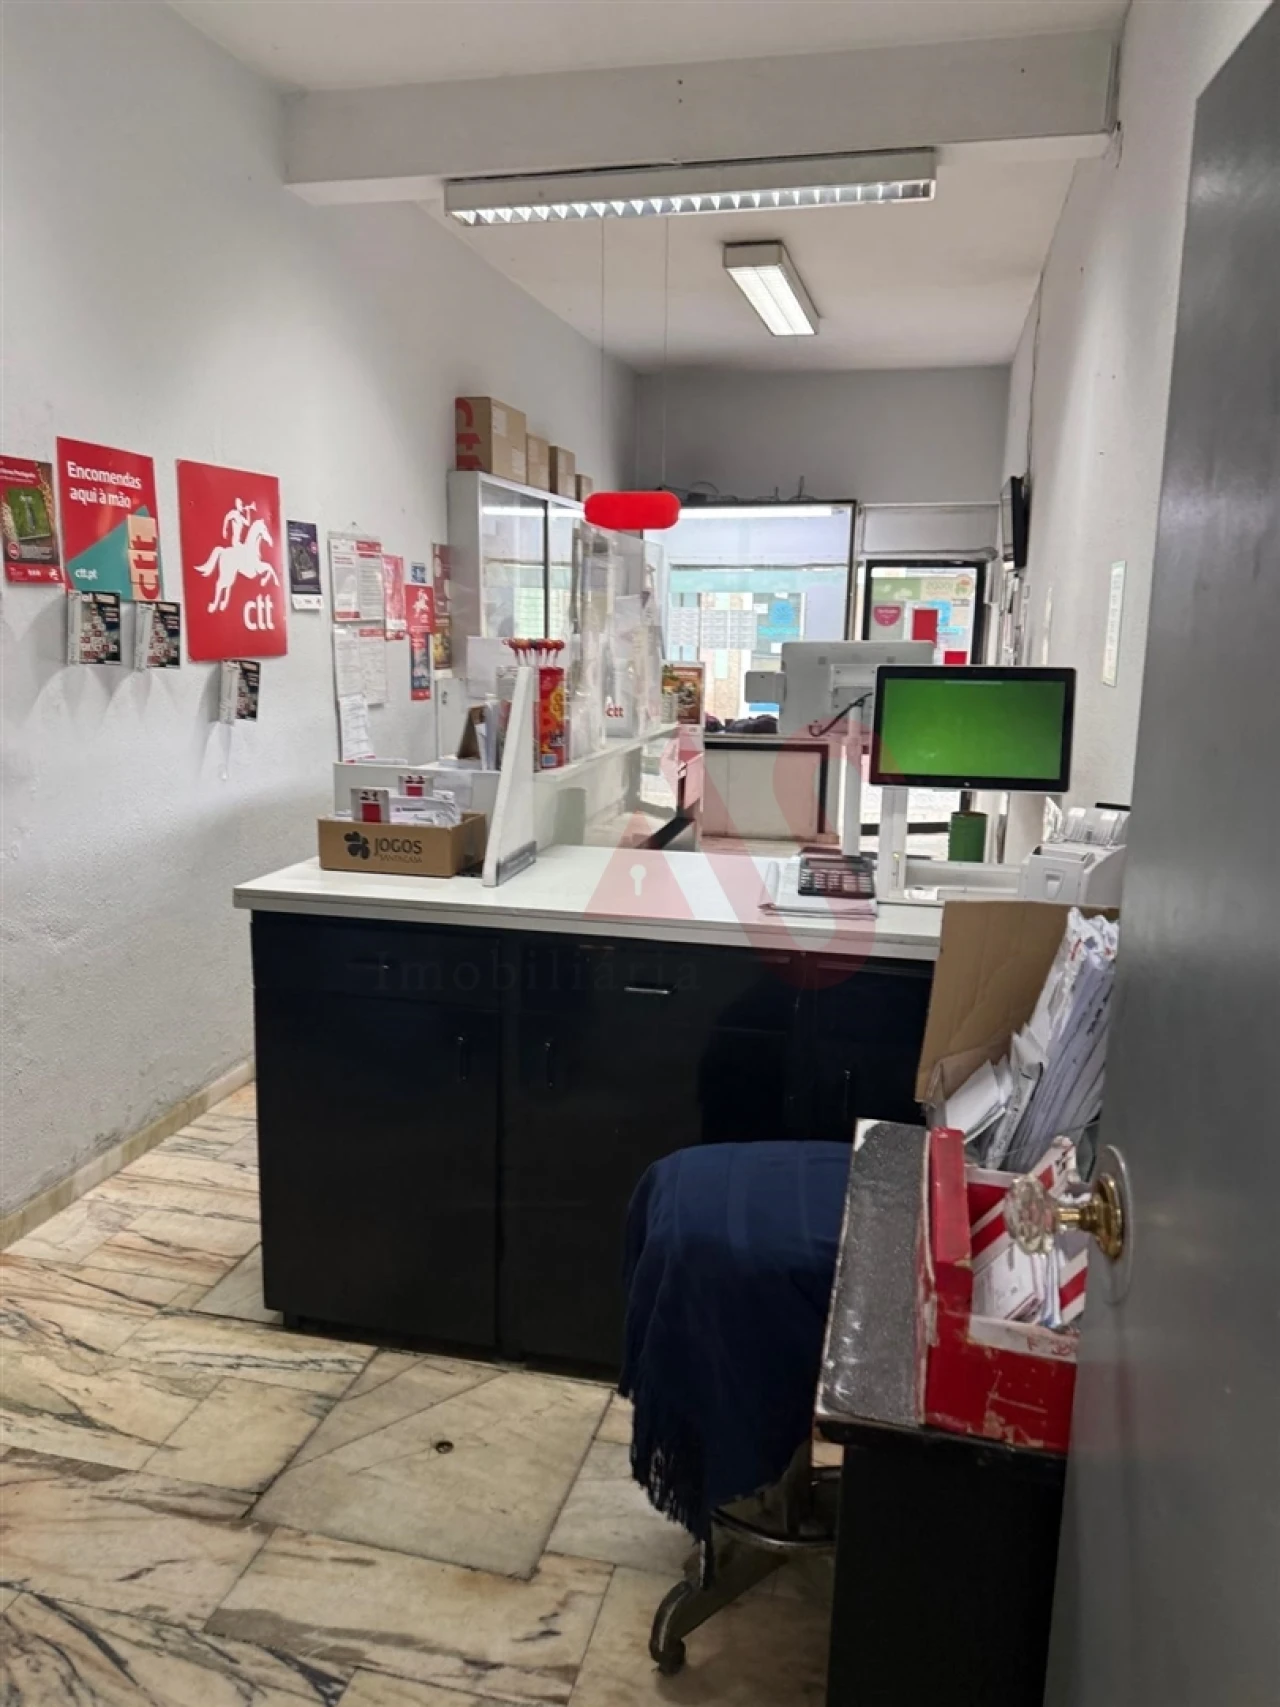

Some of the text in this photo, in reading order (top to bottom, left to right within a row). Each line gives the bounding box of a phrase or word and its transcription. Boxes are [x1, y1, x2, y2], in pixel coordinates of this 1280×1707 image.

[67, 461, 142, 489] Encomendas
[70, 488, 131, 509] aqui à mão
[243, 594, 275, 630] ctt
[604, 706, 624, 718] ctt
[374, 837, 423, 856] JOGOS
